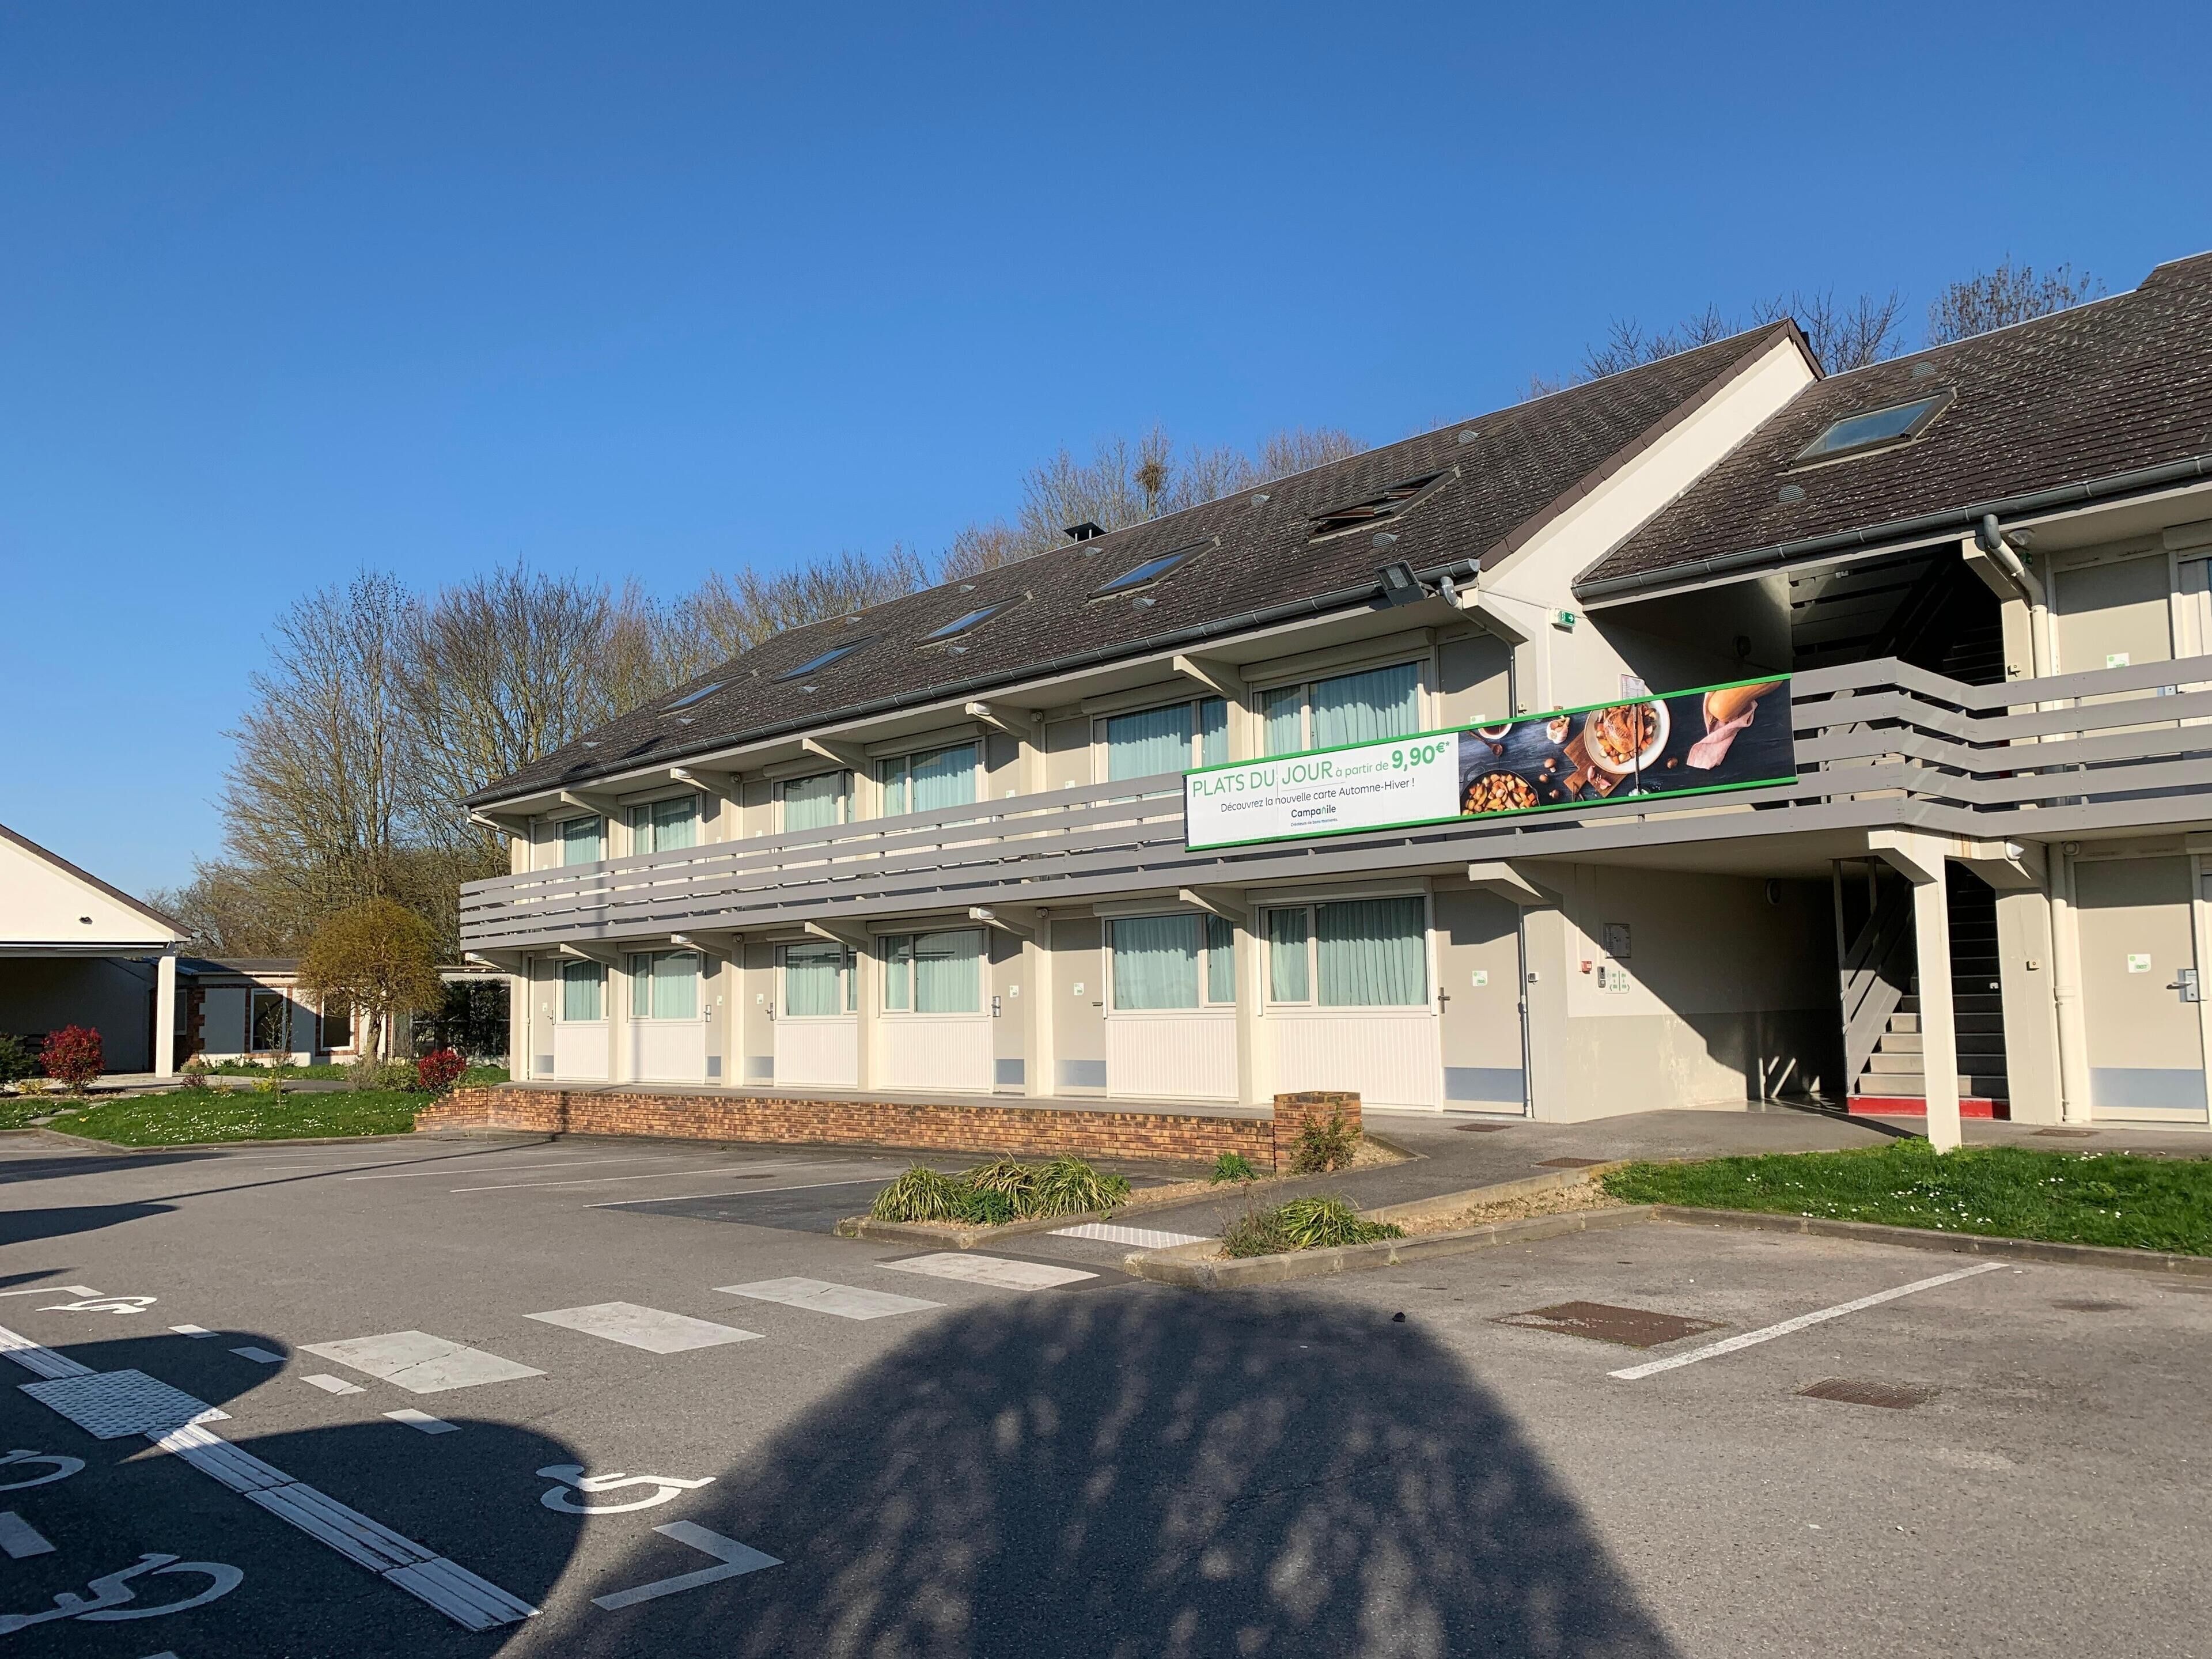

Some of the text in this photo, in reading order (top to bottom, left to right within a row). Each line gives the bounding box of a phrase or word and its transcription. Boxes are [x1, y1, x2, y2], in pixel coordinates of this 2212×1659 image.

[1193, 774, 1245, 797] PLATS
[1250, 769, 1274, 789] DU
[1282, 761, 1333, 785] JOUR
[1336, 767, 1342, 777] à
[1345, 763, 1373, 778] partir
[1376, 761, 1389, 771] de
[1221, 800, 1263, 812] Découvrez
[1265, 797, 1273, 806] la
[1275, 792, 1311, 805] nouvelle
[1313, 790, 1336, 800] carte
[1291, 804, 1336, 818] Campanile
